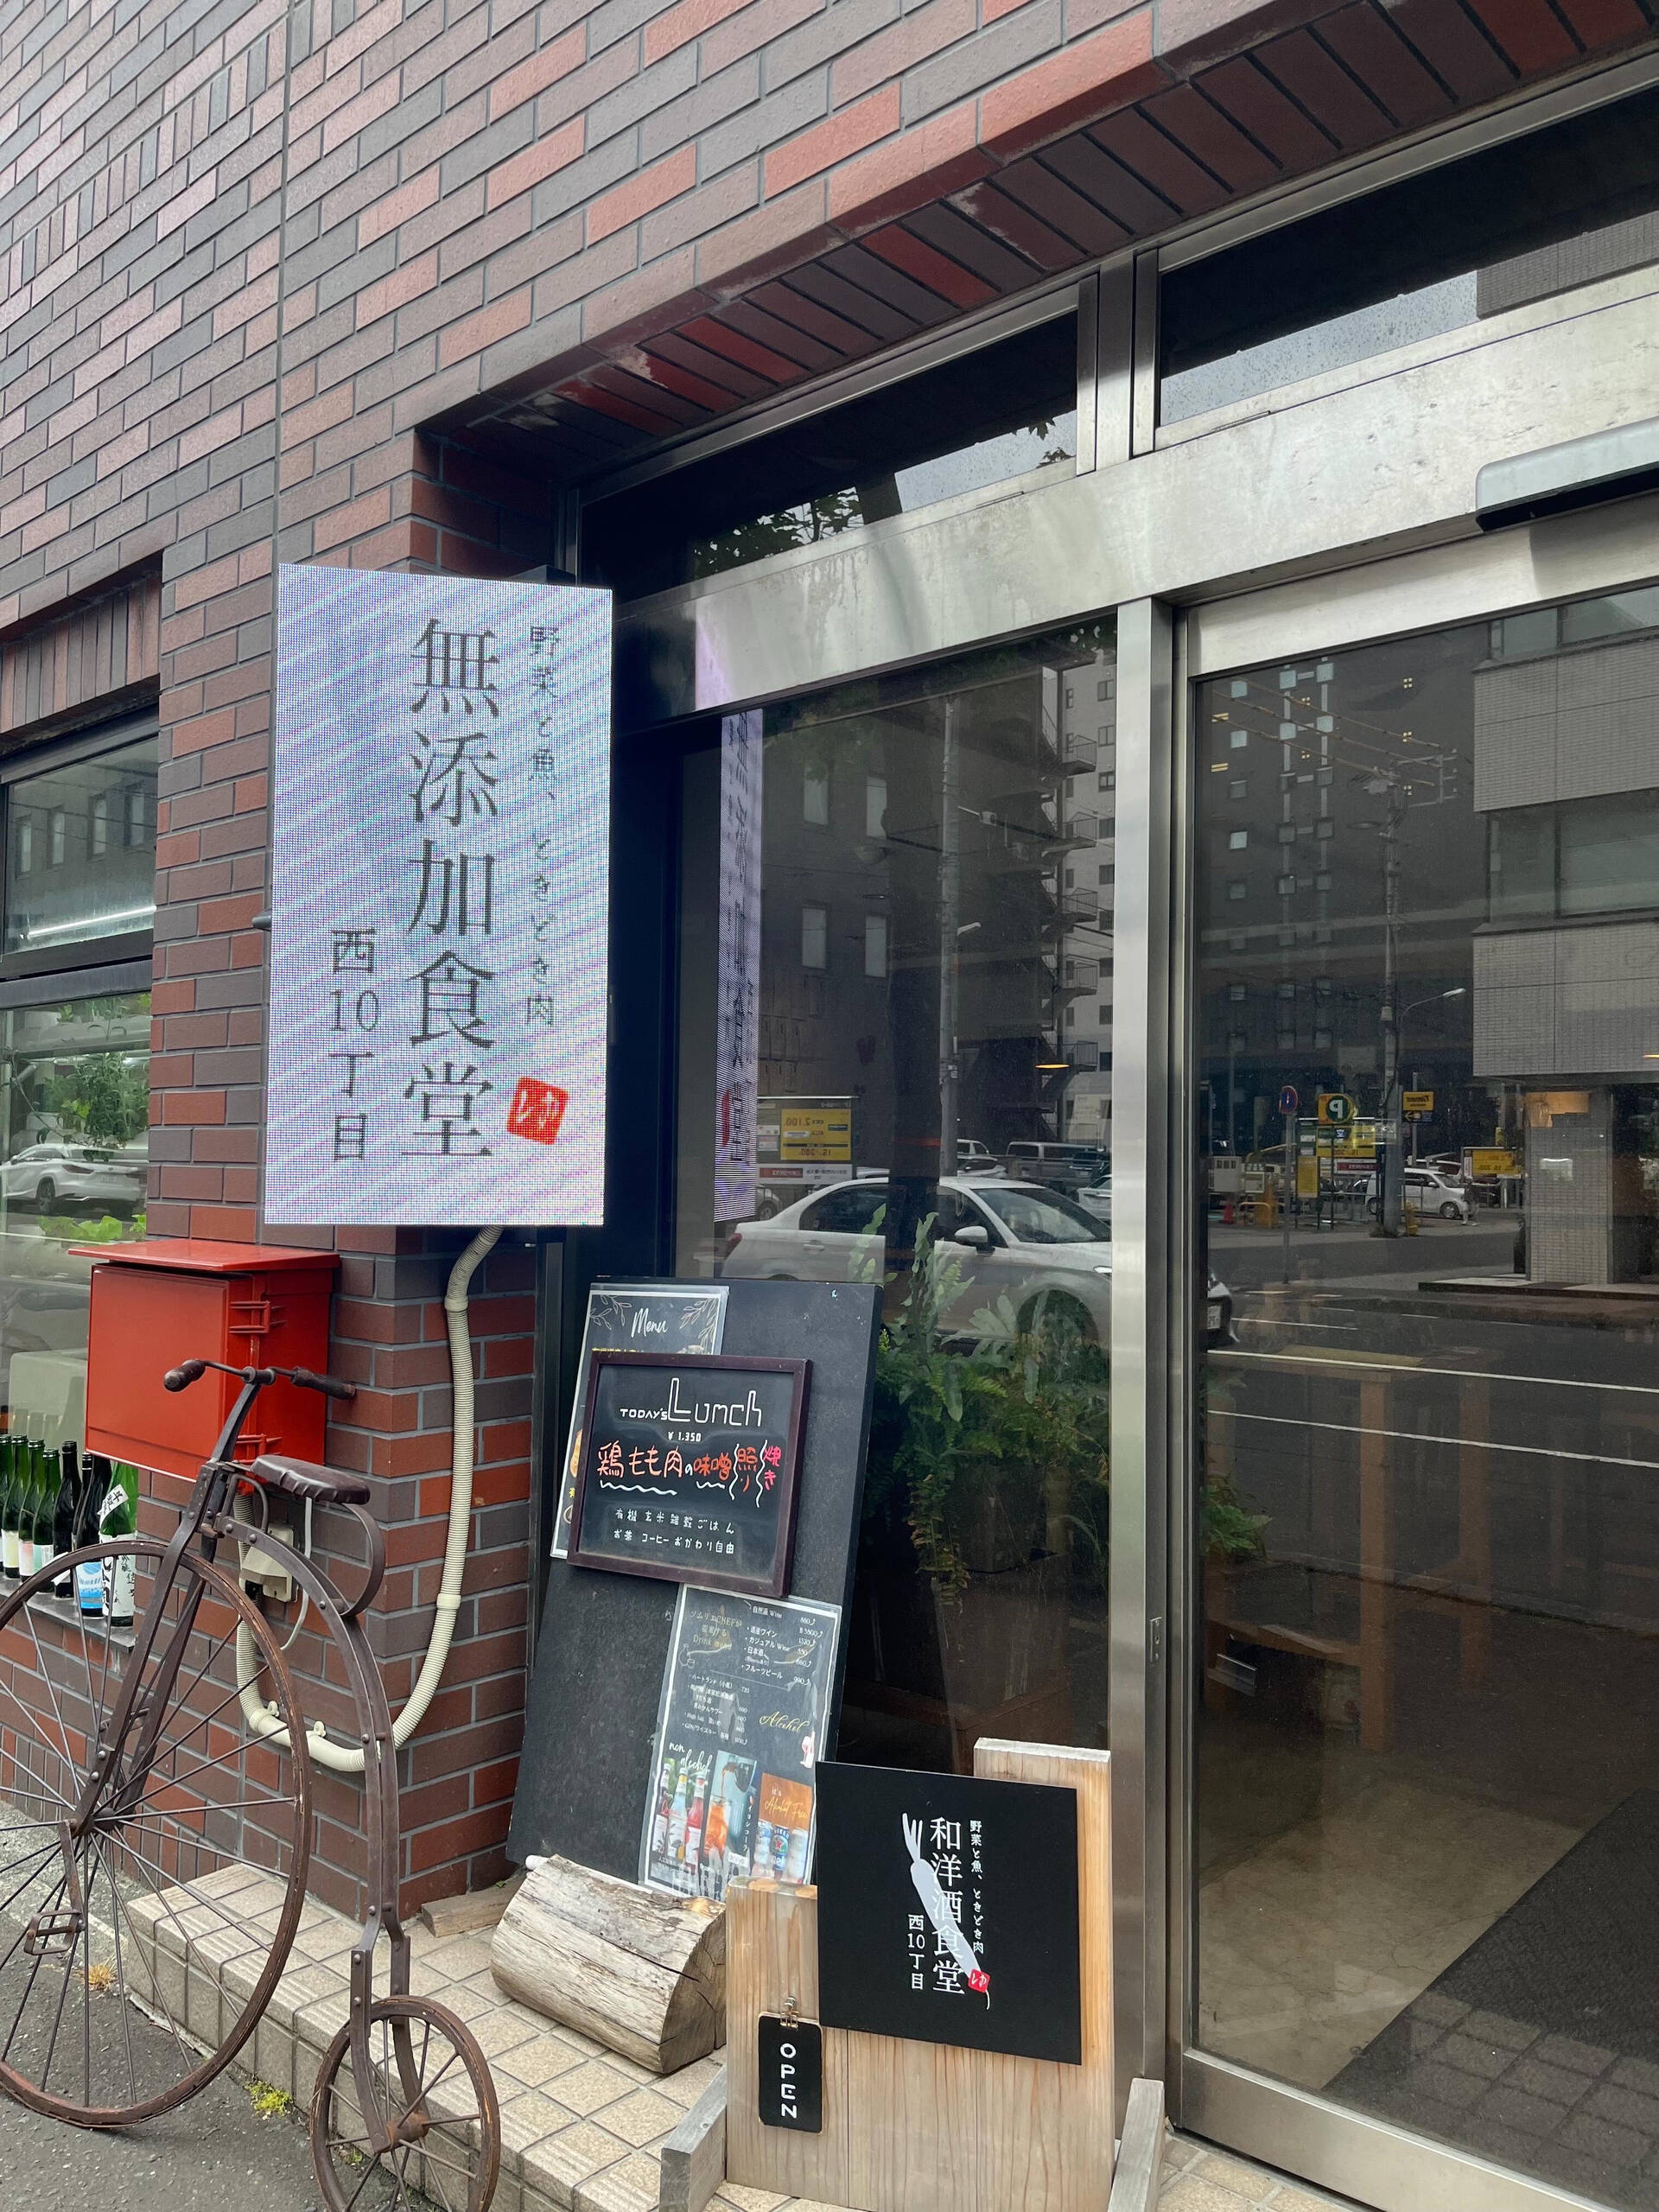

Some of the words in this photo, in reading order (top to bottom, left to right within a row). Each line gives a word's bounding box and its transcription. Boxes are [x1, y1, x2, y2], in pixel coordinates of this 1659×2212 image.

[402, 618, 500, 1158] 無添加食堂
[328, 928, 379, 1161] 西10丁目
[631, 1308, 668, 1338] Menu
[668, 1377, 762, 1427] Lunch
[759, 1711, 810, 1732] Alcohol
[930, 1816, 965, 1995] 和洋酒食堂
[907, 1914, 925, 1991] 西10丁目
[779, 2043, 798, 2119] OPEN
